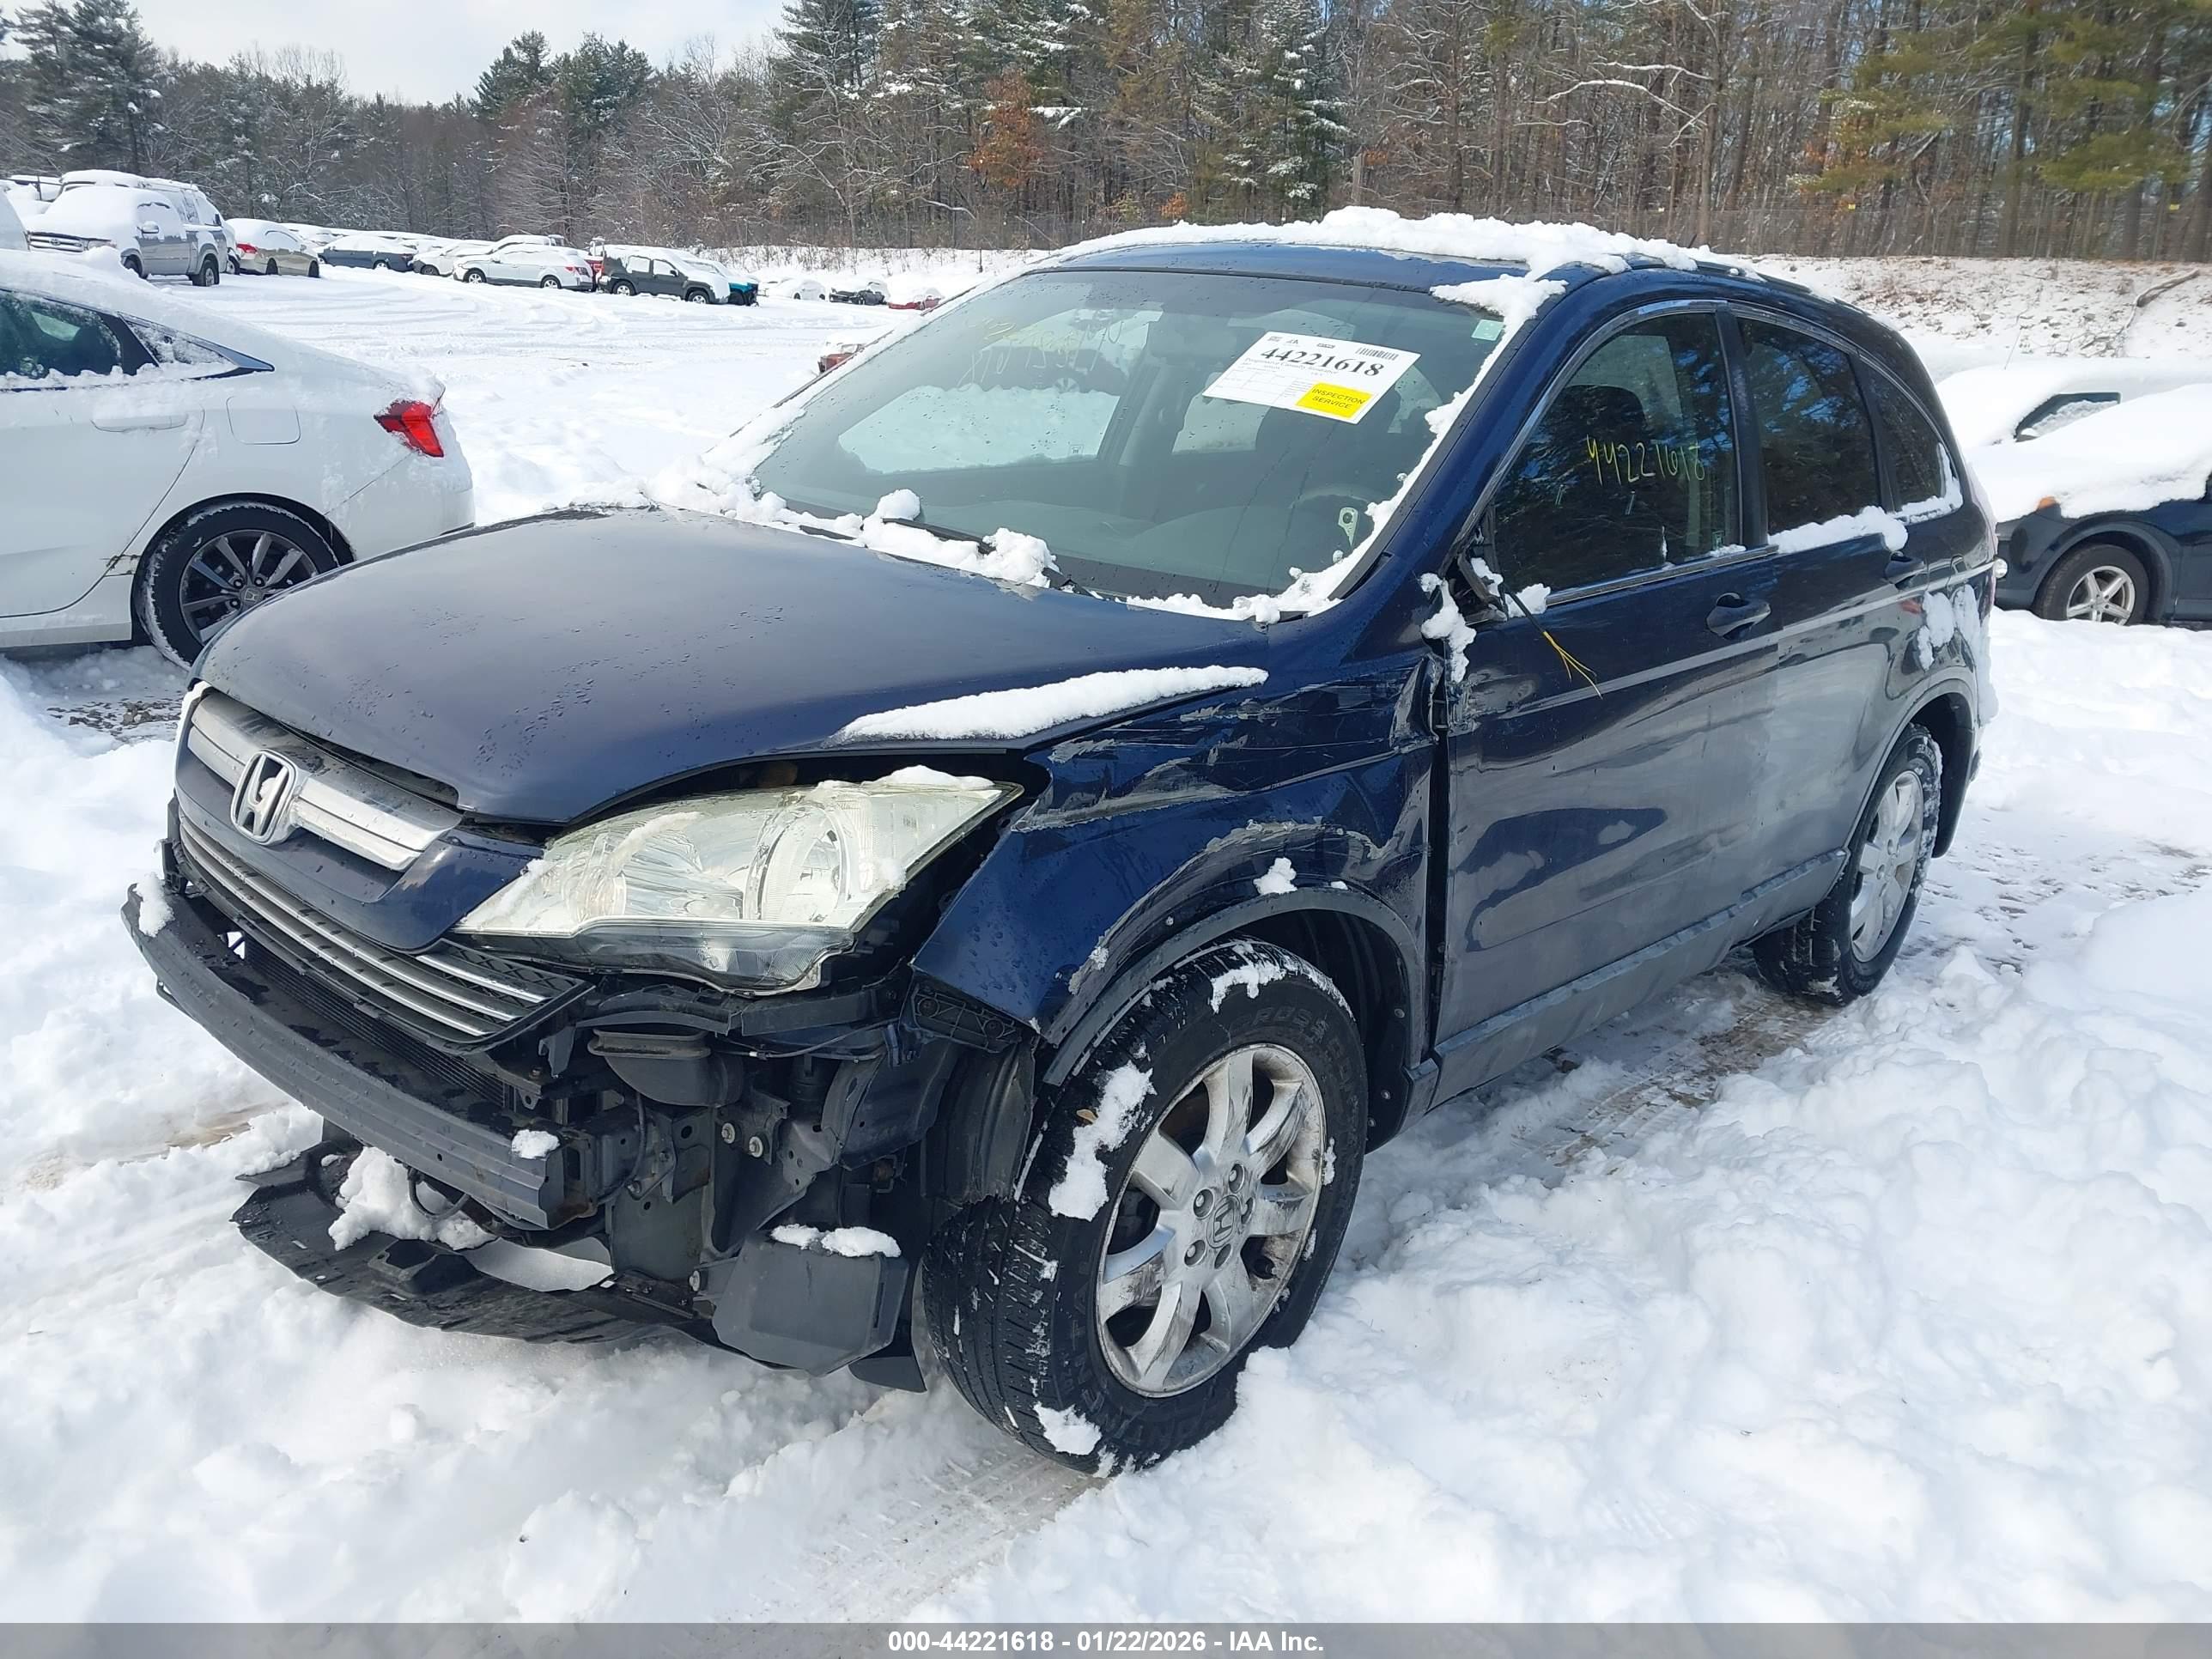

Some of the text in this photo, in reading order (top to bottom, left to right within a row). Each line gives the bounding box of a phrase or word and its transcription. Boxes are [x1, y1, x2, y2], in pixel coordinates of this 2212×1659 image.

[1260, 347, 1384, 376] 44221618
[1311, 388, 1366, 404] INSPECTION
[1311, 395, 1353, 410] SERVICE
[1586, 434, 1705, 486] 44221618
